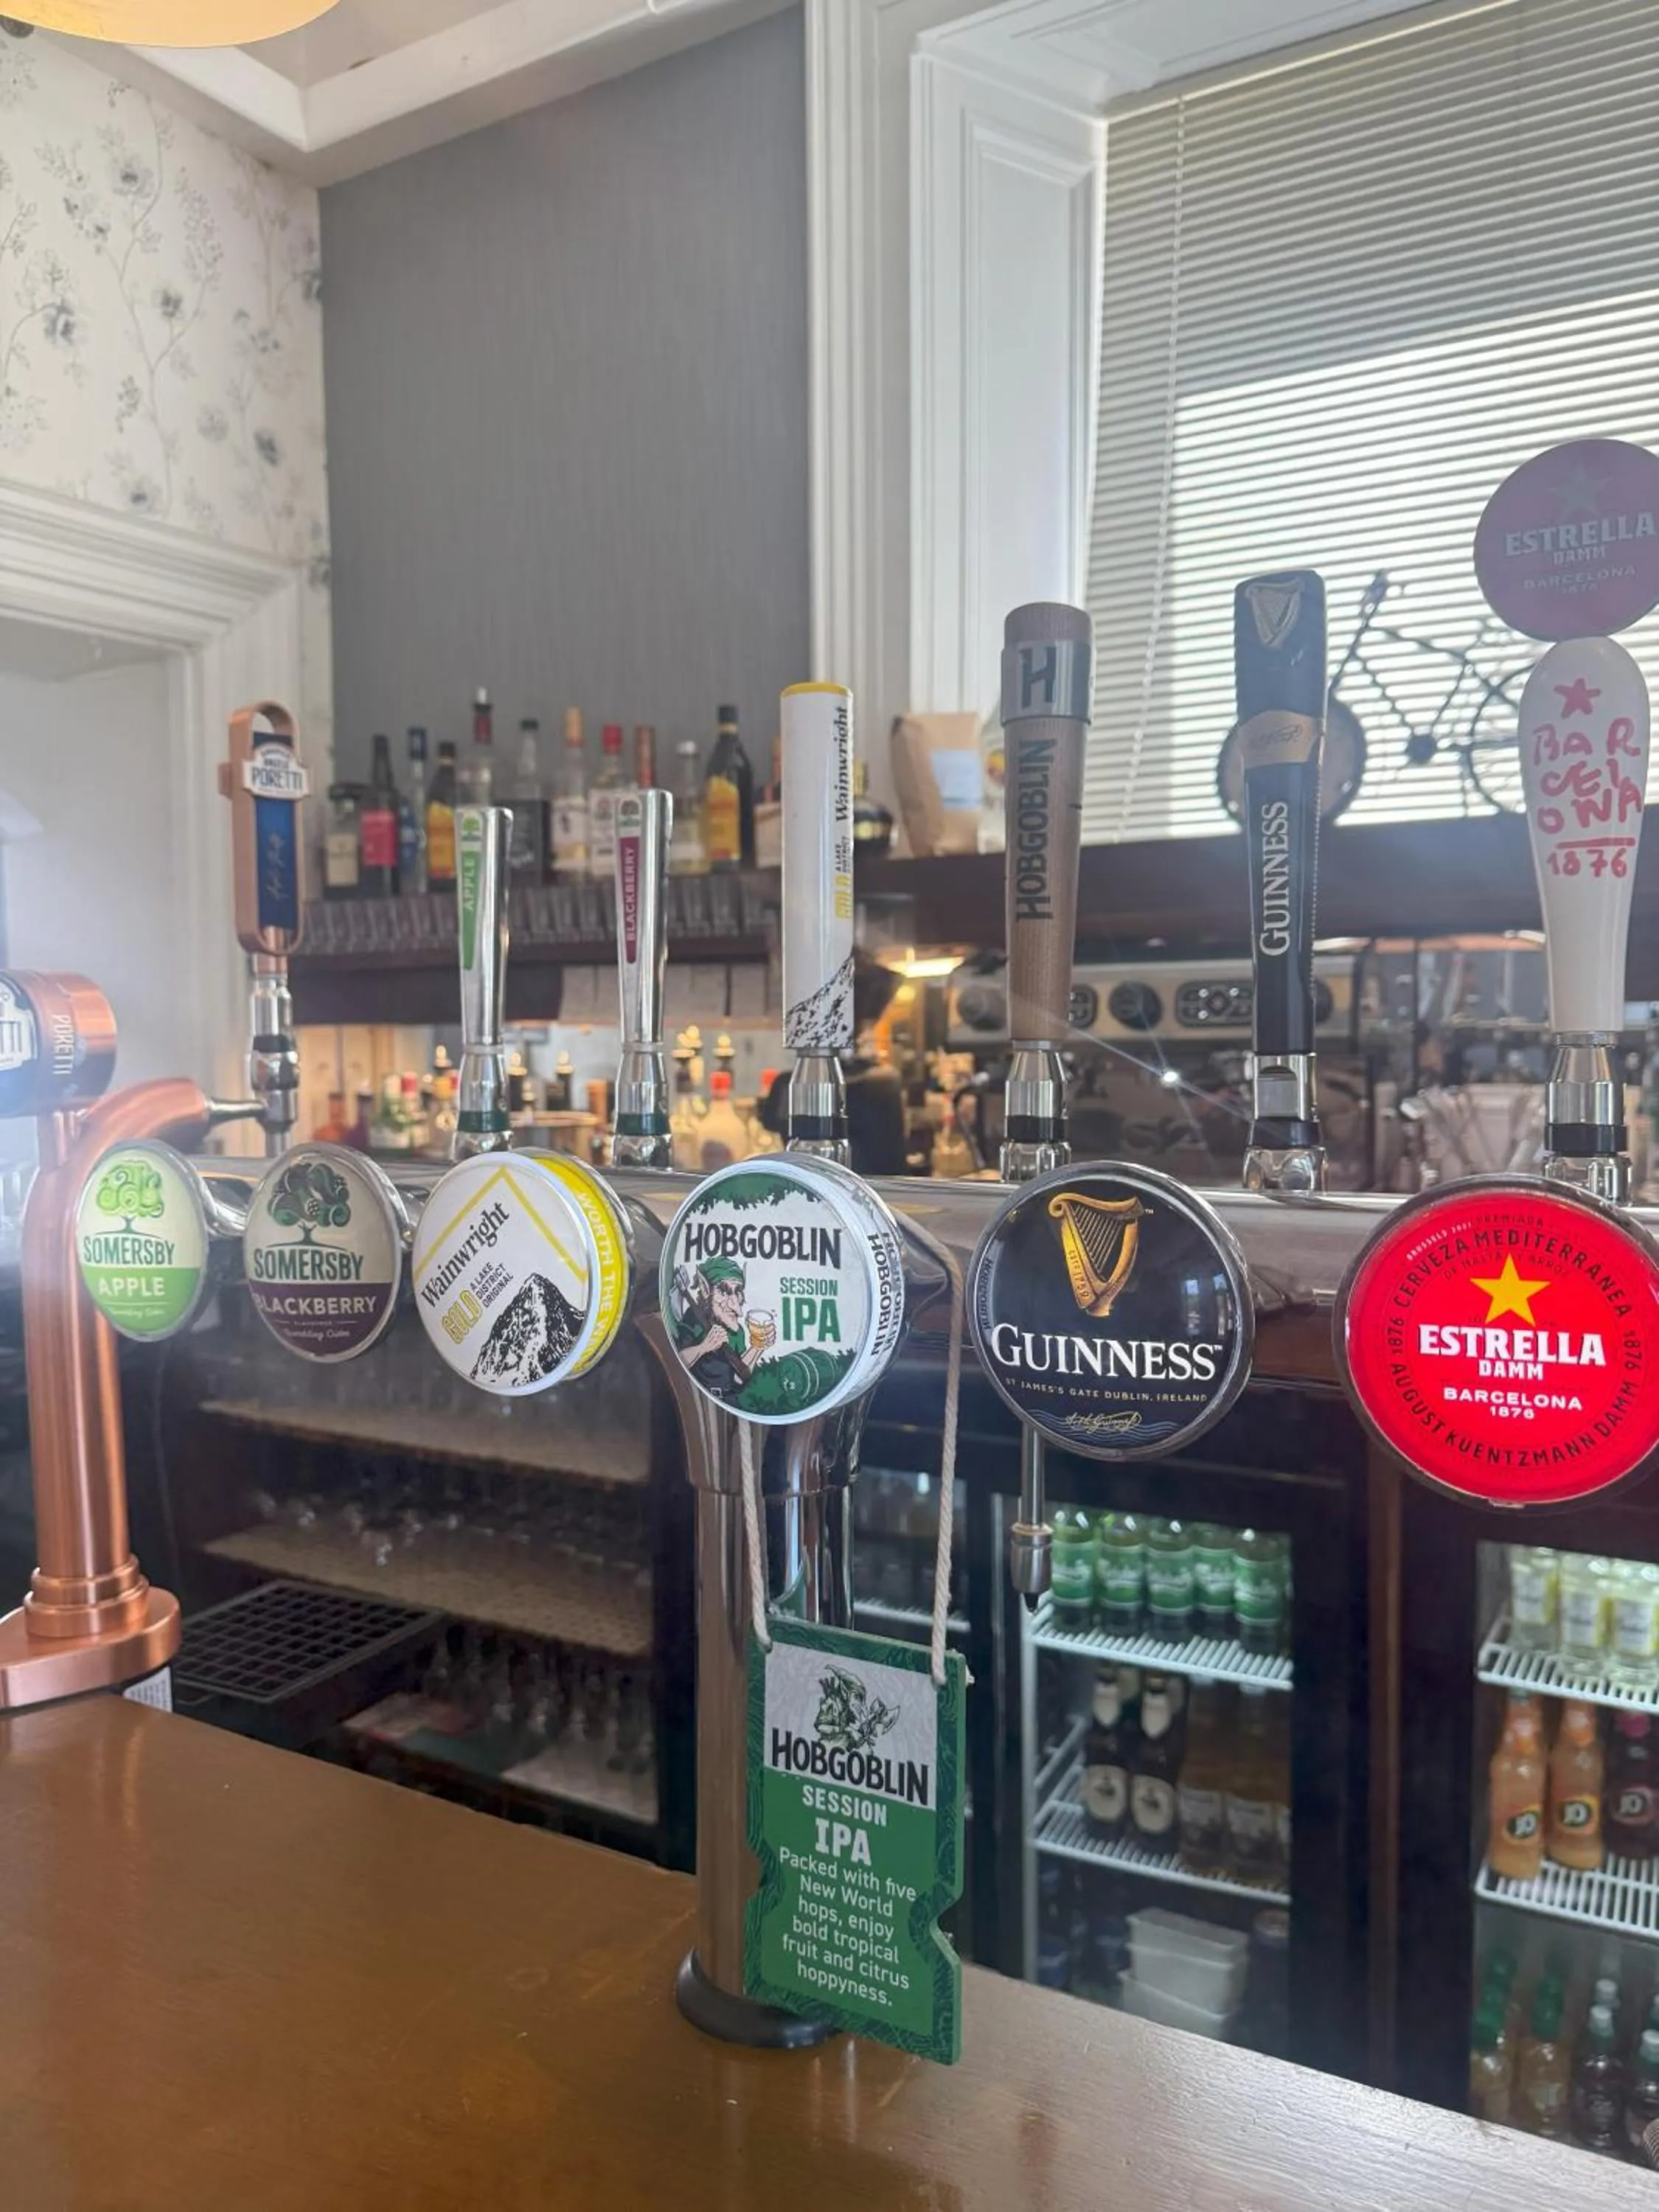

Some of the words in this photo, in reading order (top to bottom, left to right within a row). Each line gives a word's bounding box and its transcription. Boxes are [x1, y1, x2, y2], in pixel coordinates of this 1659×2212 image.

[1504, 512, 1658, 557] ESTRELLA
[1553, 546, 1607, 566] DAMM
[1523, 565, 1637, 591] BARCELONA
[1019, 646, 1057, 709] H
[252, 766, 303, 793] PORETTI
[833, 706, 849, 824] Wainwright
[1015, 737, 1058, 923] HOBGOBLIN
[464, 858, 476, 911] APPLE
[1259, 801, 1290, 957] GUINNESS
[1547, 848, 1627, 877] 1876
[625, 847, 636, 942] BLACKBERRY
[52, 1014, 74, 1074] PORETTI
[83, 1236, 175, 1265] SOMERSBY
[254, 1248, 364, 1281] SOMERSBY
[420, 1201, 509, 1309] Wainwright
[684, 1223, 842, 1270] HOBGOBLIN
[97, 1276, 166, 1298] APPLE
[474, 1262, 495, 1284] LAKE
[476, 1262, 507, 1299] DISTRICT
[481, 1273, 514, 1308] ORIGINAL
[779, 1276, 838, 1297] SESSION
[867, 1232, 892, 1356] HOBGOBLIN
[1394, 1238, 1470, 1308] CERVEZA
[251, 1293, 377, 1315] BLACKBERRY
[442, 1290, 483, 1345] GOLD
[782, 1297, 841, 1343] IPA
[991, 1324, 1217, 1382] GUINNESS
[1419, 1324, 1607, 1366] ESTRELLA
[1021, 1380, 1064, 1395] JAMES'S
[1069, 1388, 1099, 1398] GATE
[1105, 1391, 1153, 1402] DUBLIN,
[1157, 1394, 1207, 1402] IRELAND
[1478, 1360, 1543, 1380] DAMM
[1391, 1364, 1446, 1433] AUGUST
[1445, 1429, 1596, 1467] KUENTZMANN
[1593, 1380, 1639, 1438] DAMM
[1443, 1388, 1582, 1411] BARCELONA
[1489, 1406, 1534, 1419] 1876
[772, 1727, 929, 1806] HOBGOBLIN
[802, 1784, 887, 1828] SESSION
[815, 1818, 872, 1867] IPA
[779, 1846, 838, 1879] Packed
[843, 1868, 880, 1891] with
[886, 1877, 917, 1902] five
[800, 1874, 836, 1900] New
[841, 1885, 894, 1917] World
[793, 1916, 828, 1941] bold
[834, 1931, 900, 1964] tropical
[799, 1896, 843, 1927] hops,
[848, 1916, 895, 1943] enjoy
[782, 1934, 818, 1960] fruit
[823, 1949, 853, 1971] and
[859, 1961, 910, 1990] citrus
[797, 1959, 893, 2006] hoppyness.
